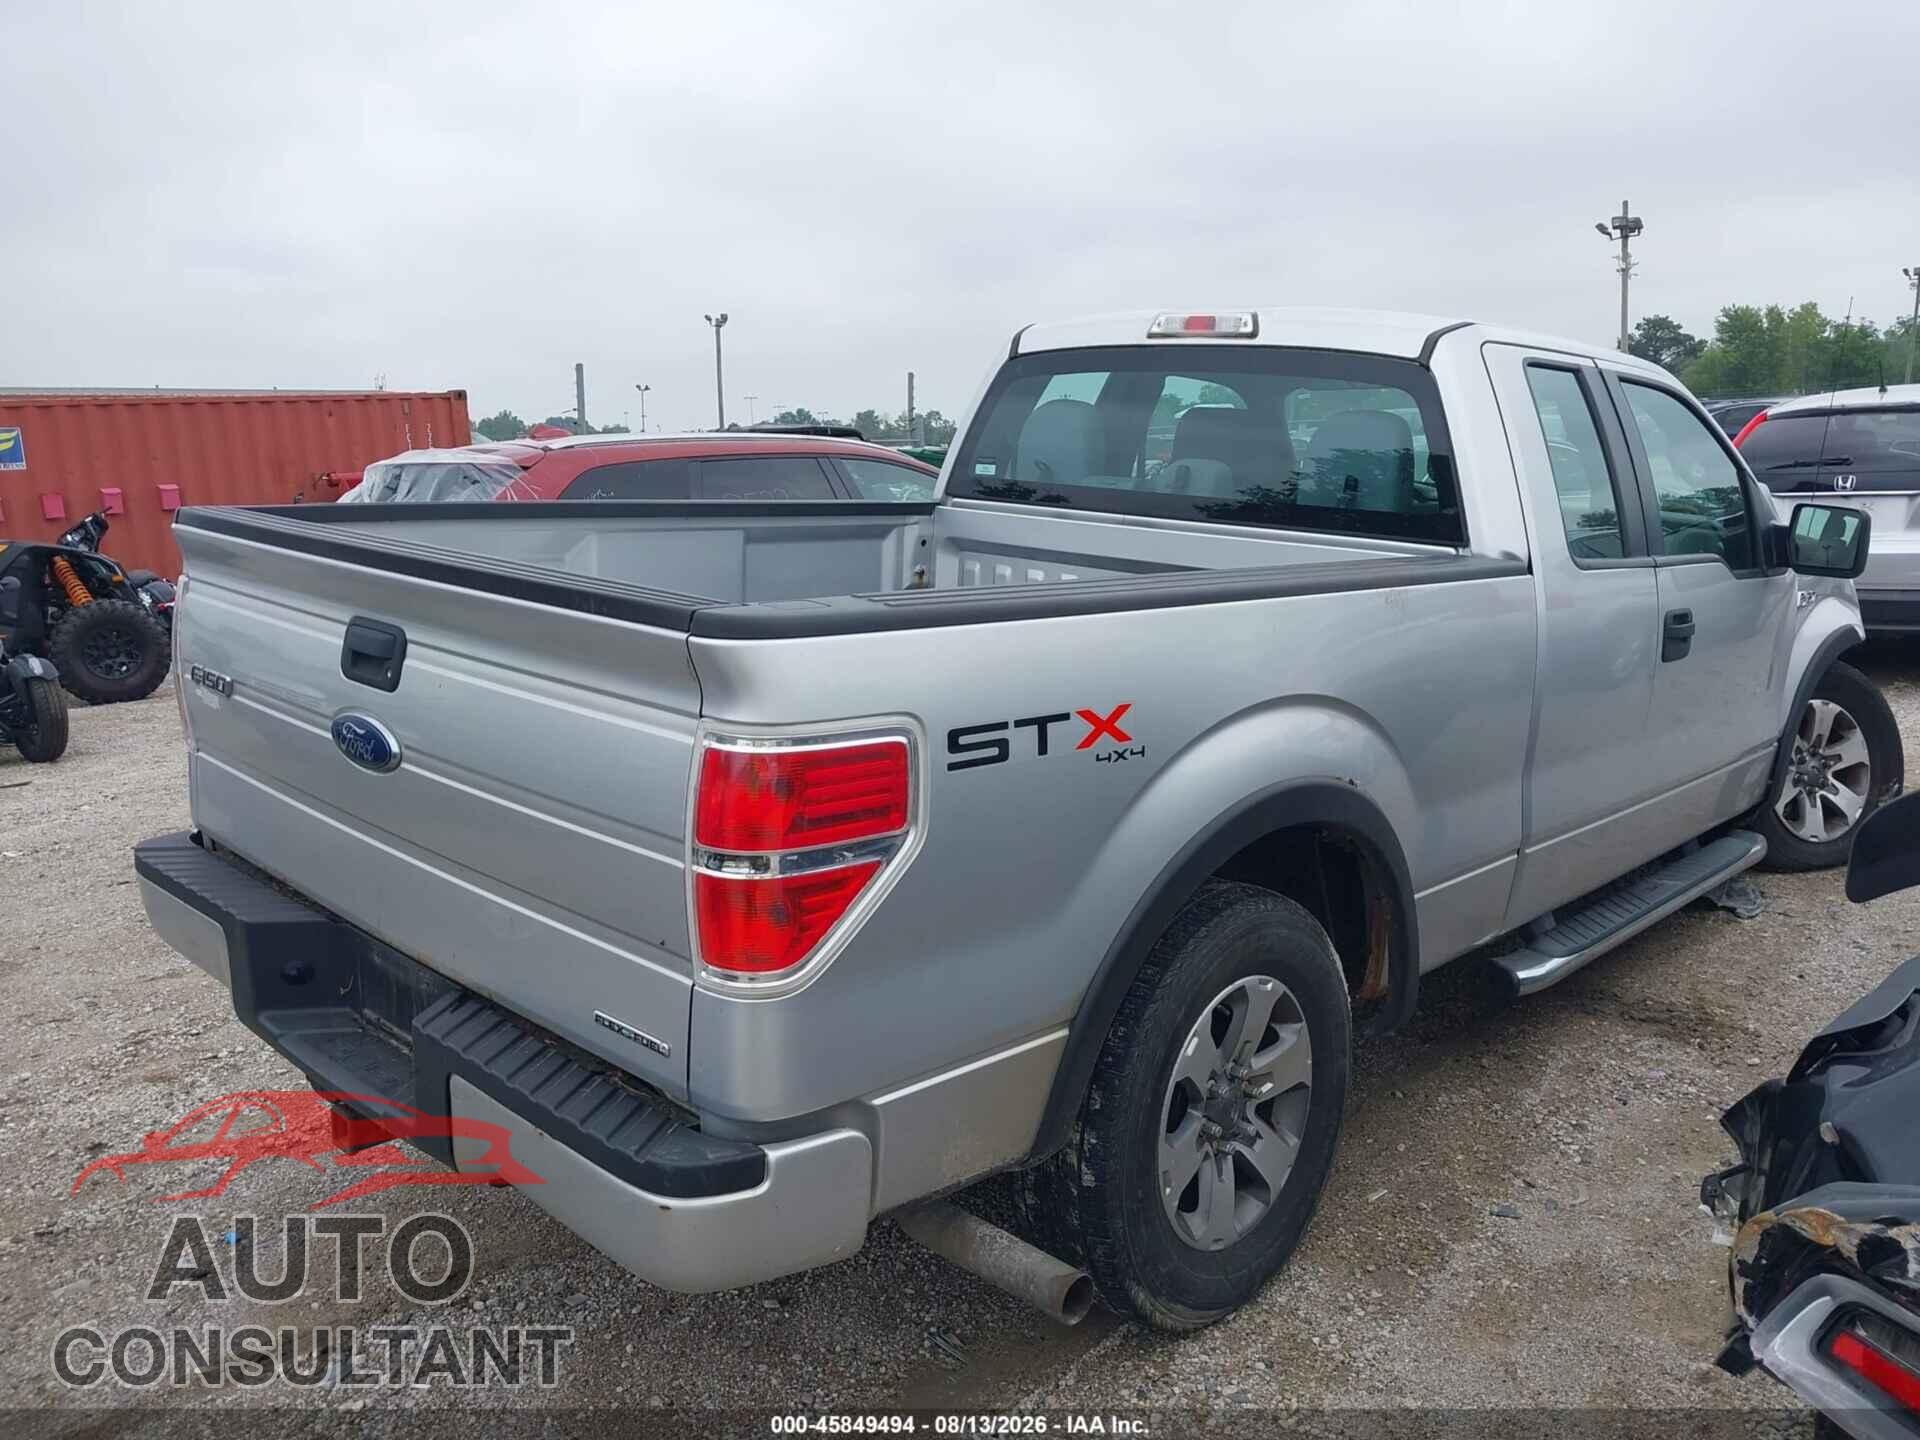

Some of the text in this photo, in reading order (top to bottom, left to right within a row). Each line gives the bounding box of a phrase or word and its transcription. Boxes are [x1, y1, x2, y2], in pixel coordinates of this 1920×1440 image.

[341, 721, 376, 761] Ford
[946, 703, 1133, 772] STX
[594, 1012, 624, 1035] FLEX
